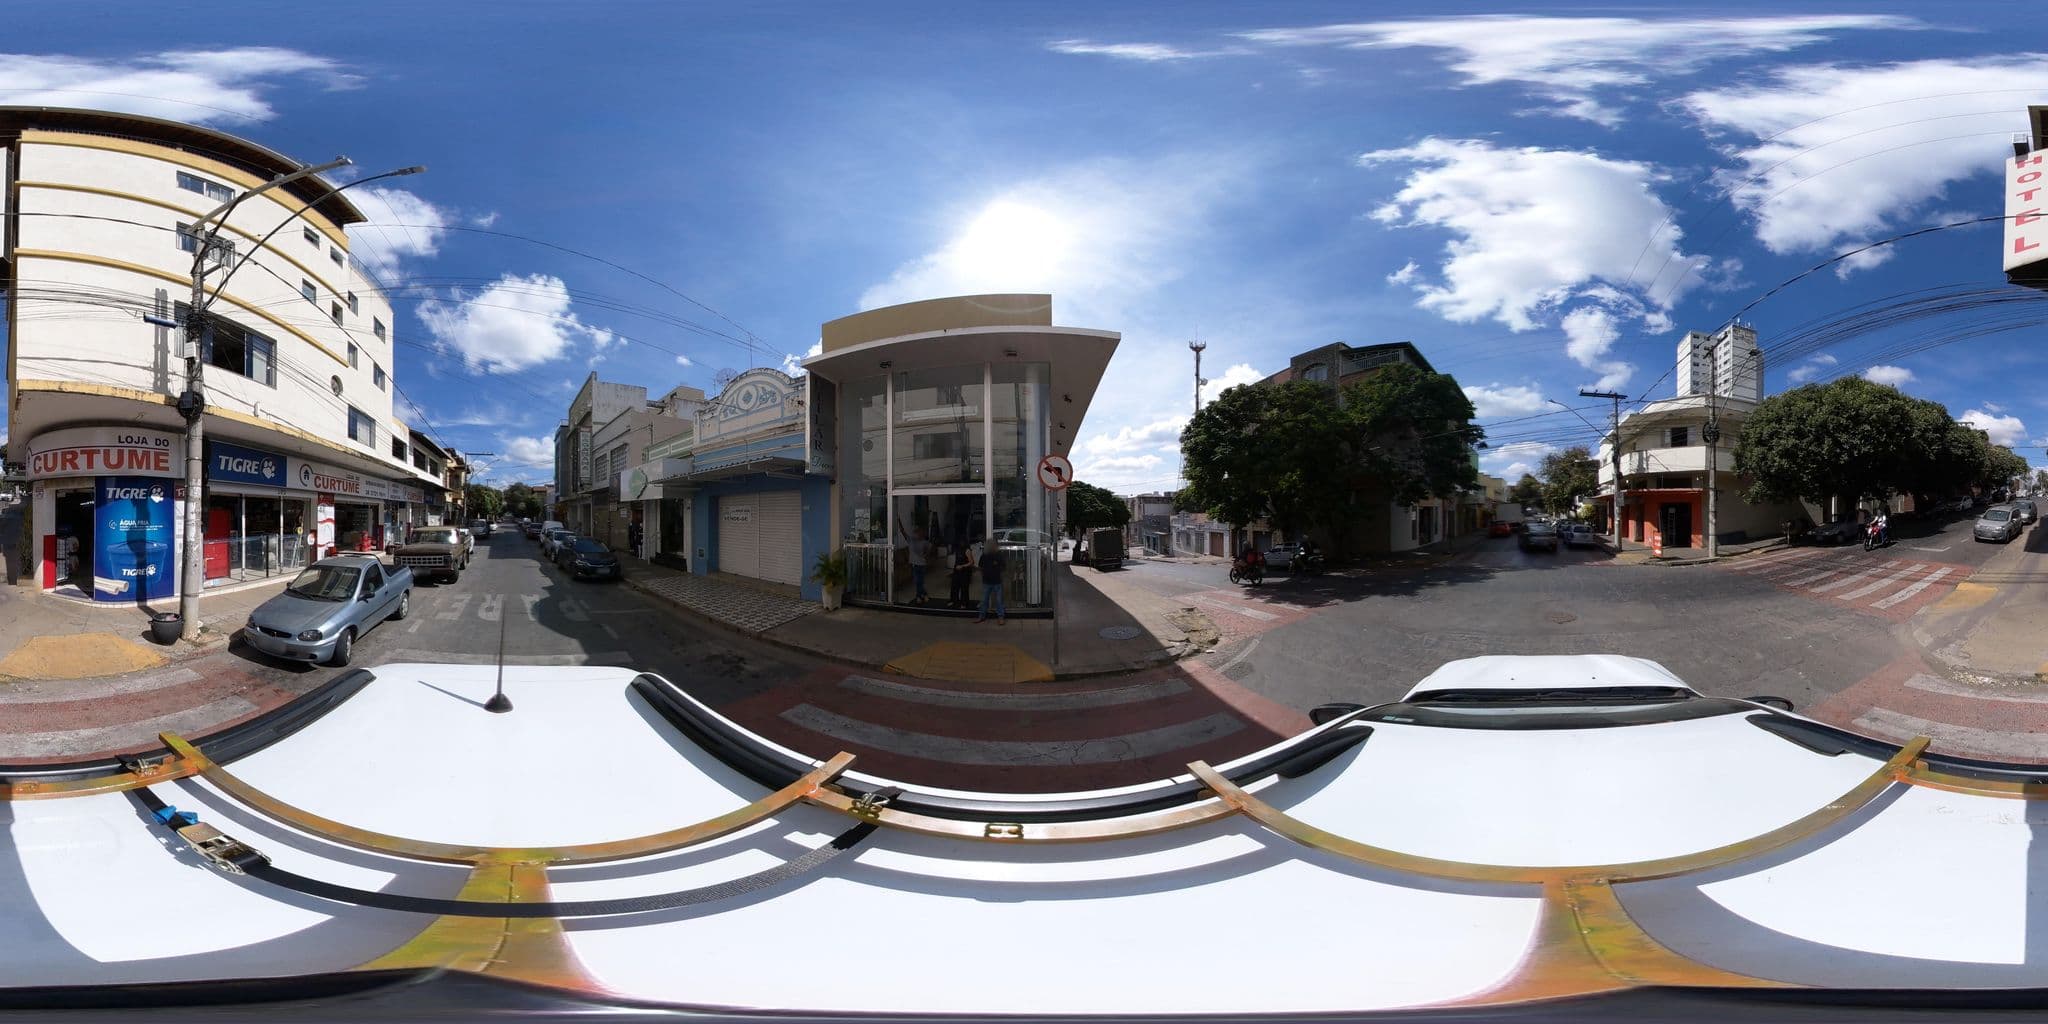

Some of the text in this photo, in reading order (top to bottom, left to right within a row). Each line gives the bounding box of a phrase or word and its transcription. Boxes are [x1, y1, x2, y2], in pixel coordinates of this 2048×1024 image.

[2014, 155, 2042, 254] HOTEL
[118, 435, 169, 447] LOJA DO
[33, 449, 170, 474] CURTUME
[218, 455, 260, 475] TIGRE
[106, 487, 148, 499] TIGRE
[313, 475, 360, 494] CURTUME
[122, 568, 147, 577] TIGRE
